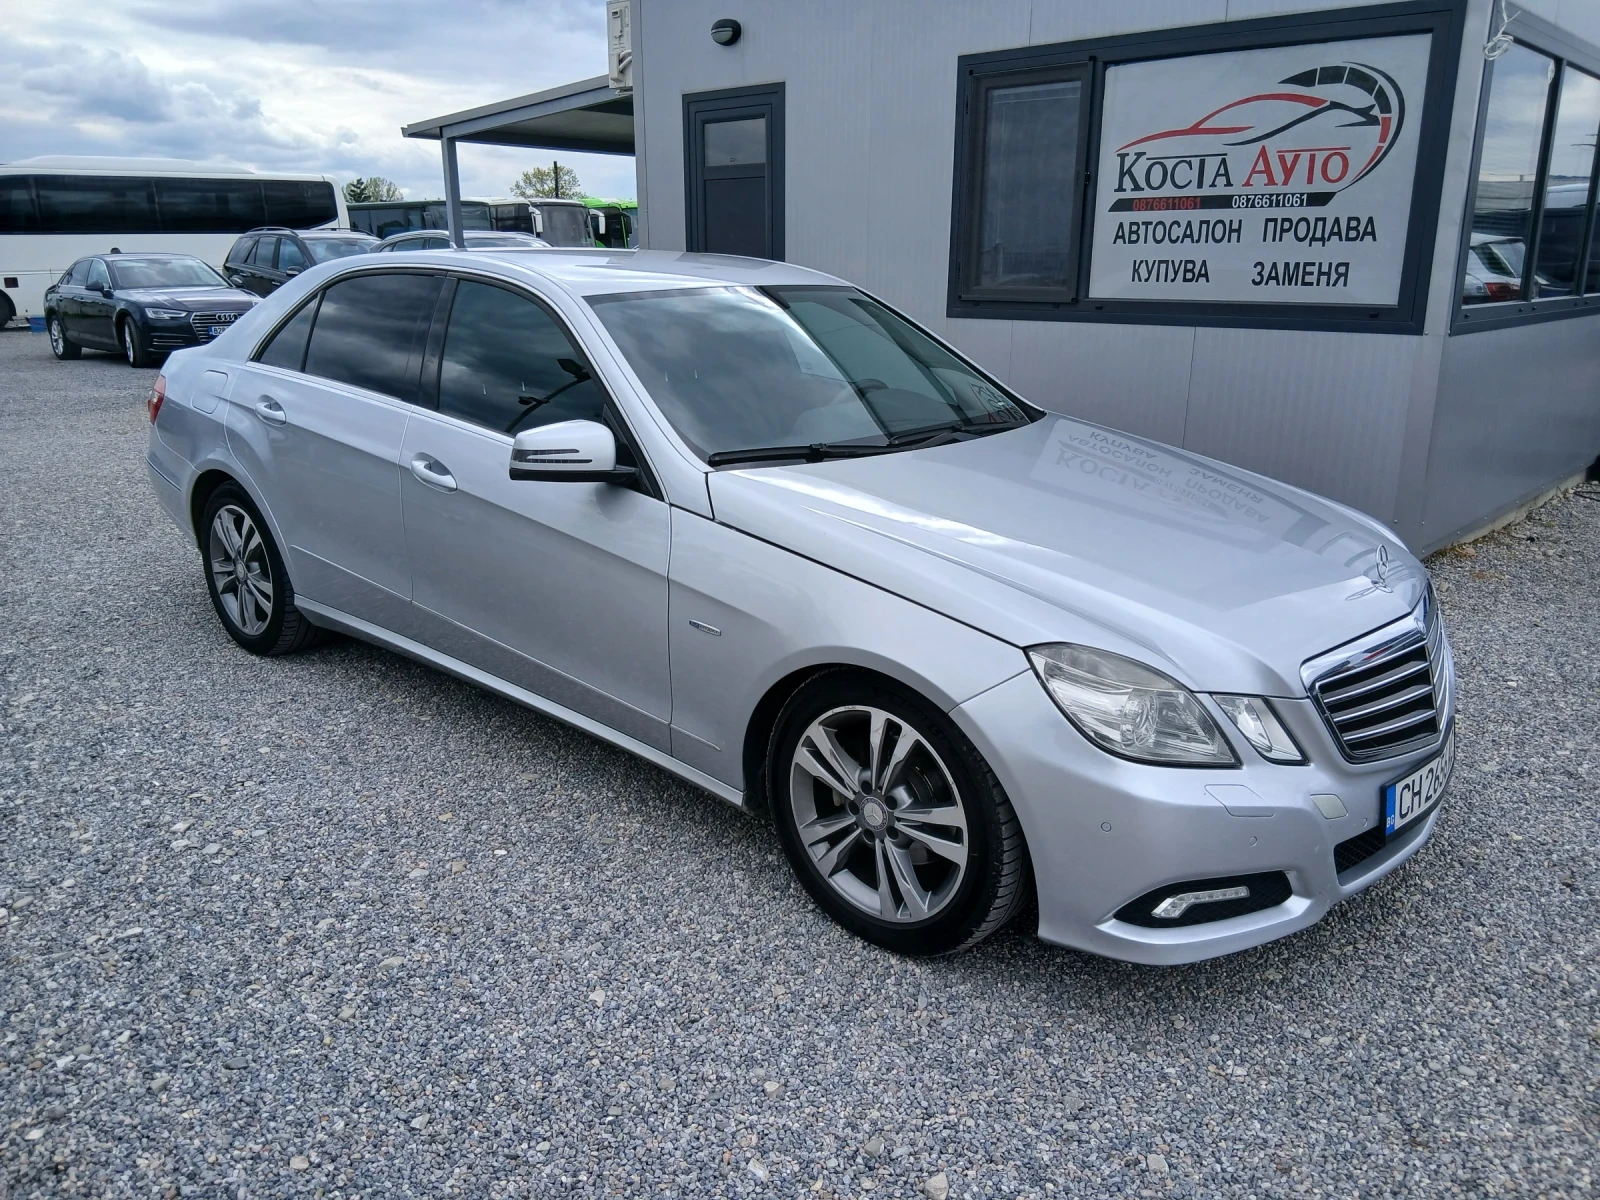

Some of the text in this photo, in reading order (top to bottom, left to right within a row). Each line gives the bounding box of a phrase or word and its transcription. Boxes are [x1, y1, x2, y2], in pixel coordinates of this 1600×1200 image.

[1133, 193, 1308, 211] 0876611061 0876611061
[1113, 216, 1377, 247] АВТОСАЛОН ПРОДАВА
[1131, 260, 1350, 287] КУПУВА ЗАМЕНЯ
[1399, 774, 1422, 819] CH
[1386, 815, 1395, 828] BG
